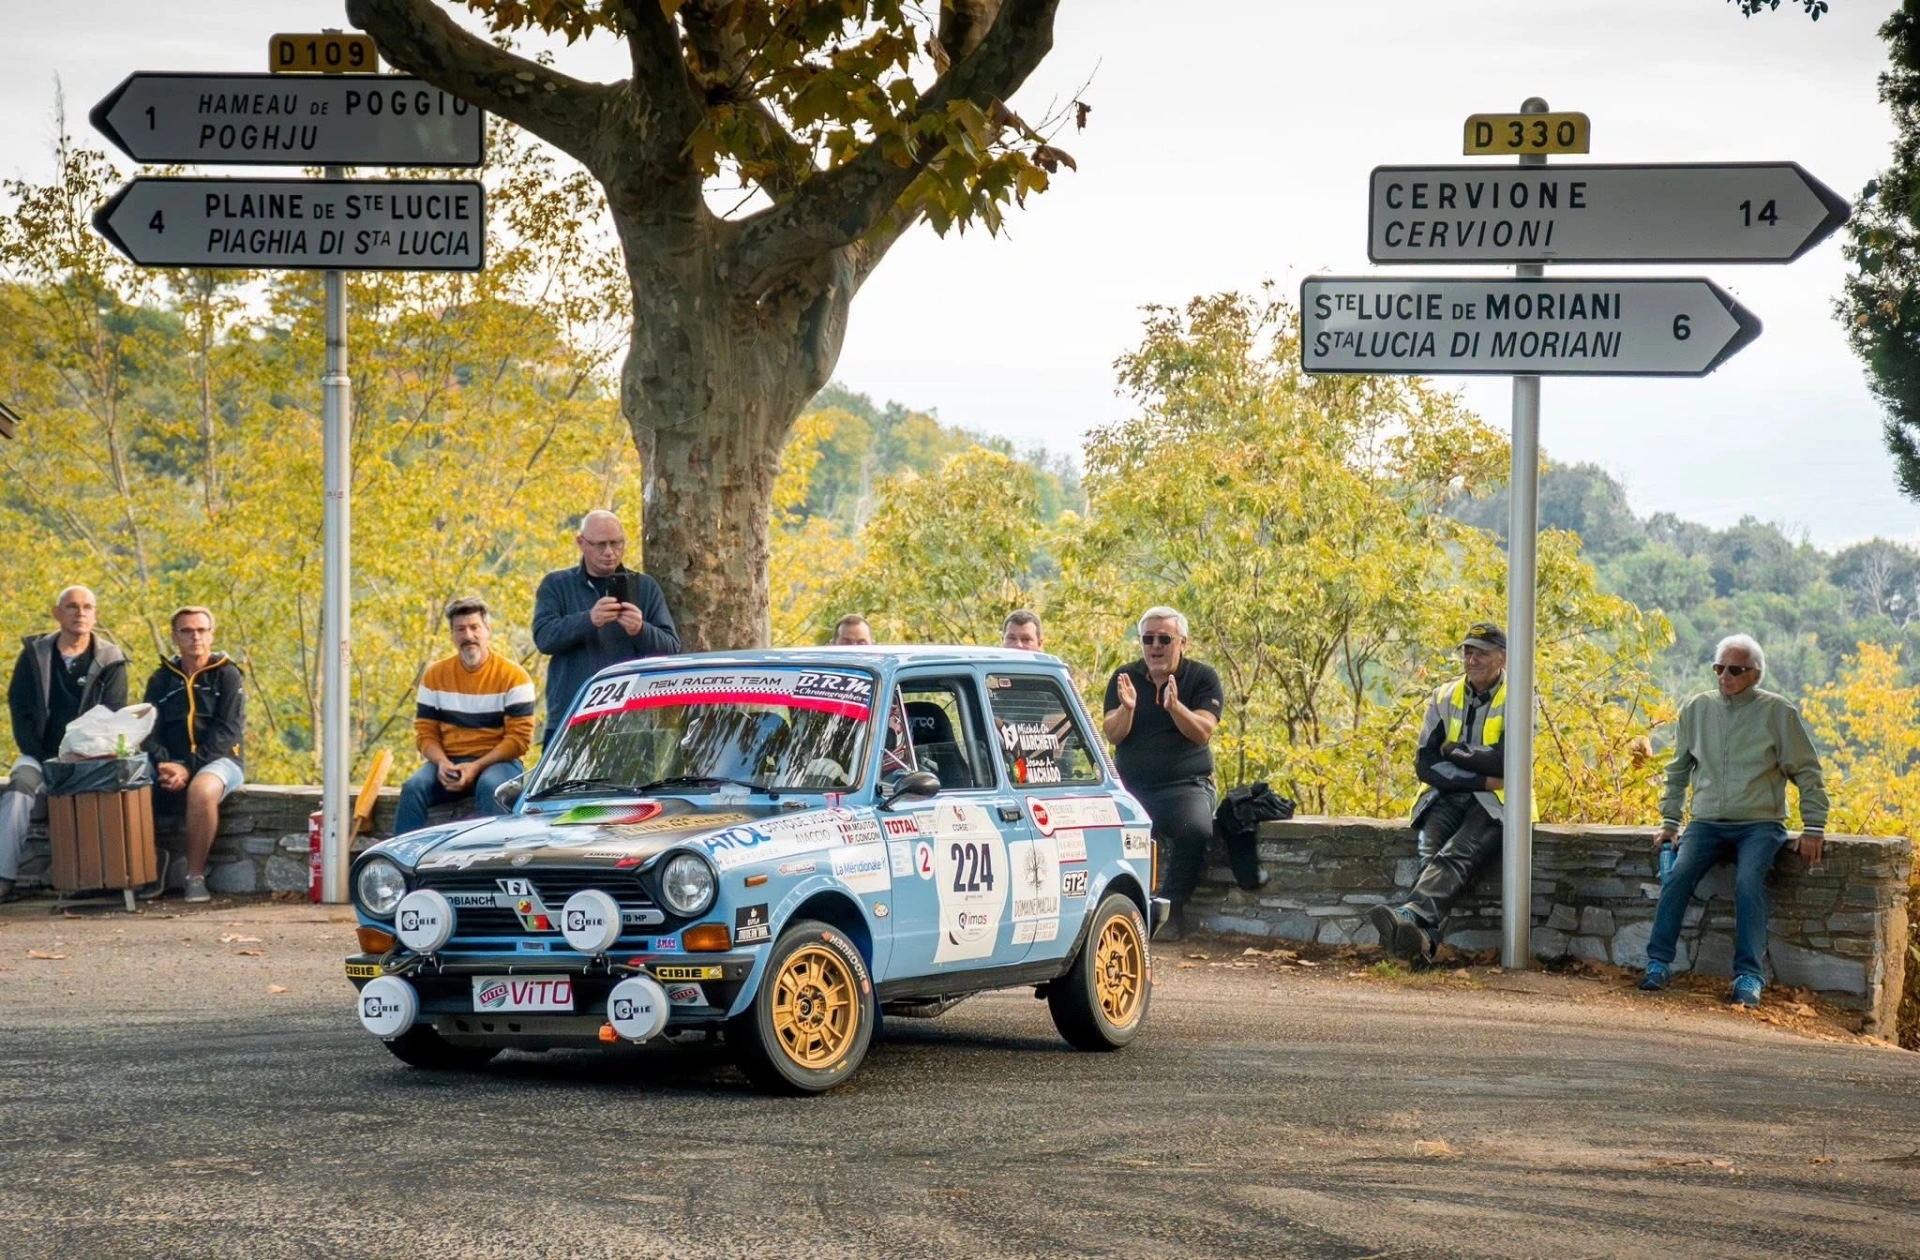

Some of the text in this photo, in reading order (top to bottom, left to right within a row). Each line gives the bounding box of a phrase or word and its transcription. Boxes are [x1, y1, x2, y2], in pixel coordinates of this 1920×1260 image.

[280, 41, 364, 66] D 109
[199, 94, 297, 114] HAMEAU
[310, 102, 328, 115] DE
[146, 106, 155, 130] 1
[200, 125, 317, 150] POGHJU
[1476, 121, 1575, 147] D 330
[206, 194, 303, 218] PLAINE
[314, 204, 334, 219] DE
[392, 195, 469, 219] LUCIE
[1387, 182, 1586, 209] CERVIONE
[149, 210, 164, 233] 4
[1740, 200, 1778, 226] 14
[208, 229, 306, 254] PIAGHIA
[319, 231, 344, 254] DI
[399, 231, 469, 255] LUCIA
[1386, 221, 1553, 247] CERVIONI
[1453, 304, 1476, 319] DE
[1487, 294, 1620, 319] MORIANI
[1673, 314, 1690, 340] 6
[1450, 332, 1480, 357] DI
[1491, 332, 1621, 357] MORIANI
[583, 681, 630, 709] 224
[649, 676, 781, 689] NEW RACING TEAM
[760, 815, 809, 833] OPTIQUE
[885, 819, 919, 835] TOTAL
[835, 864, 844, 876] La
[920, 847, 931, 873] 2
[951, 843, 994, 892] 224
[408, 917, 436, 926] CIBIE
[574, 918, 603, 926] CIBIE
[658, 968, 703, 978] CIBIE
[370, 1004, 400, 1012] CIBIE
[621, 1005, 652, 1014] CIBIE
